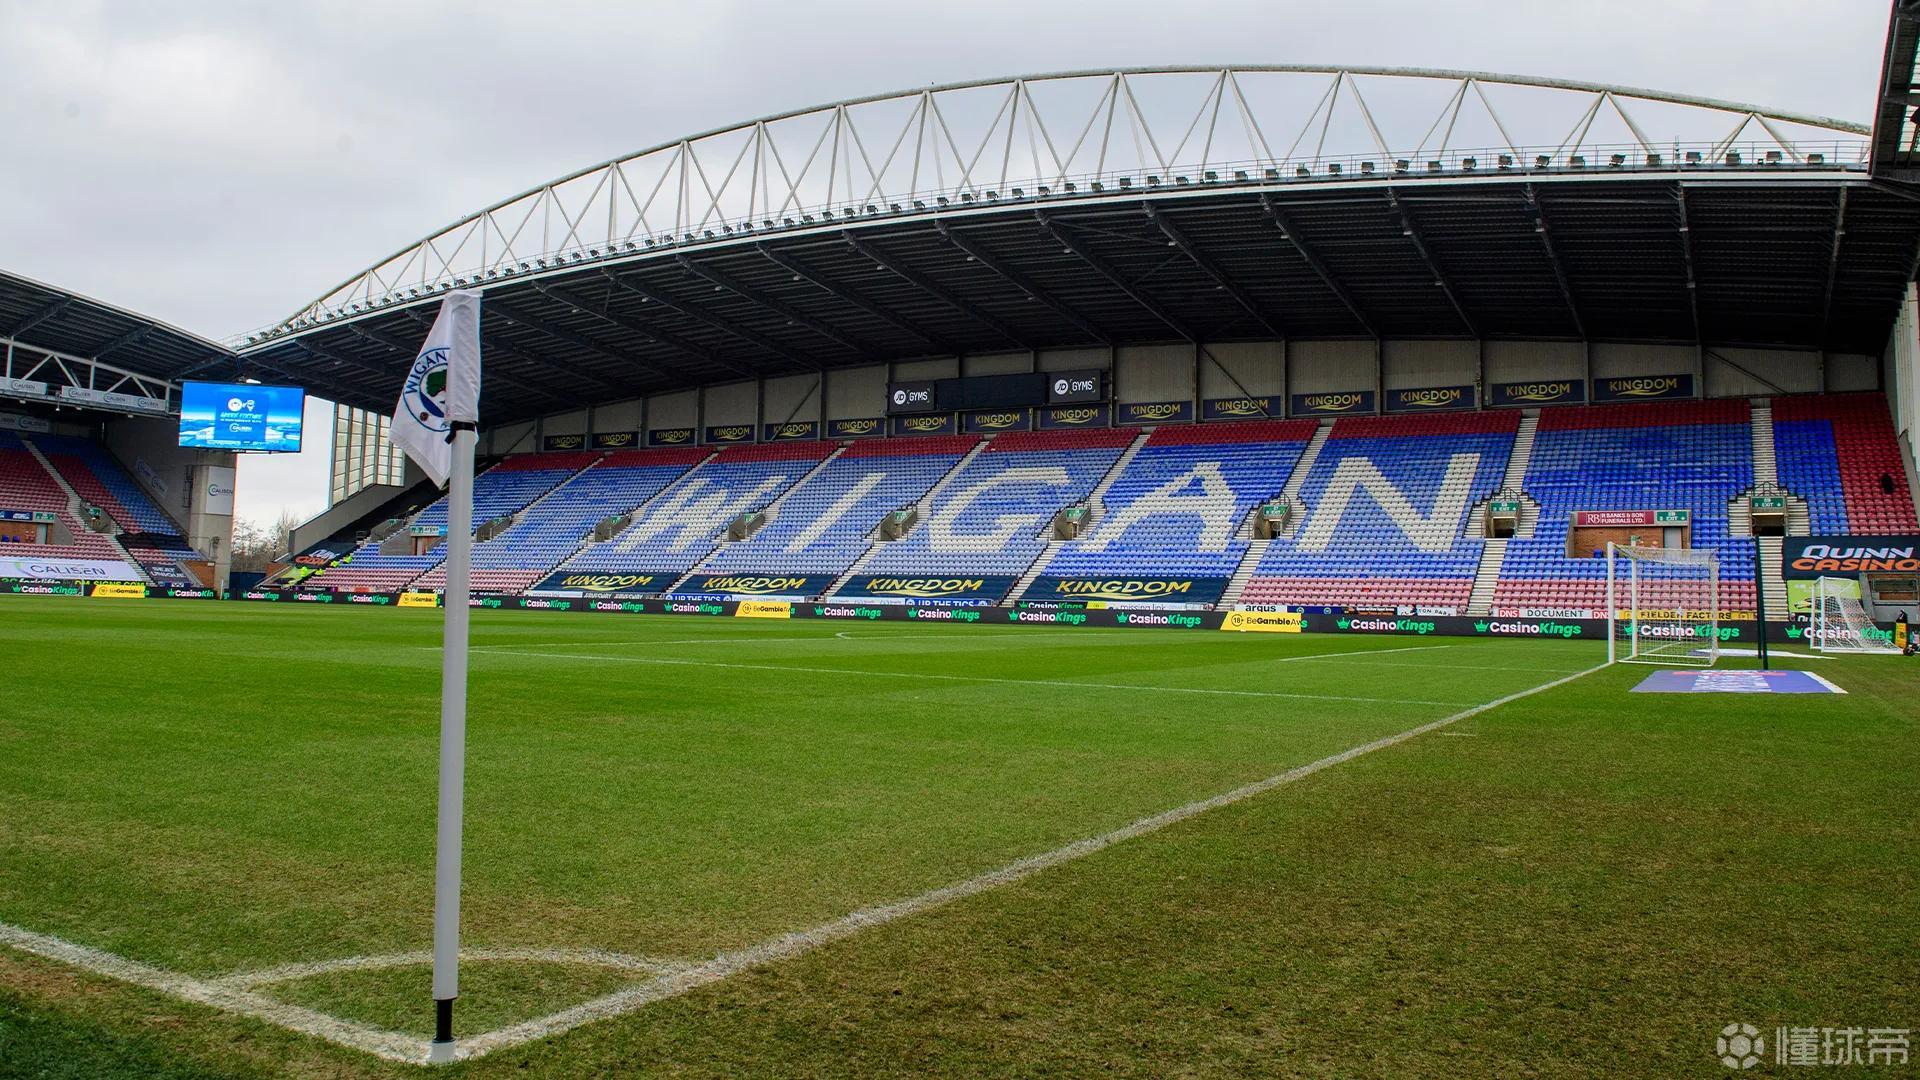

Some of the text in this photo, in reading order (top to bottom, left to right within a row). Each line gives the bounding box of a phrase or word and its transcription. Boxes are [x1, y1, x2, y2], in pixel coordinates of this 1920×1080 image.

[405, 350, 447, 394] WIGAN
[1072, 380, 1093, 392] GYMS
[1506, 383, 1570, 396] KINGDOM
[1609, 378, 1678, 392] KINGDOM
[909, 391, 928, 402] GYMS
[1305, 394, 1361, 407] KINGDOM
[1400, 389, 1461, 402] KINGDOM
[1051, 409, 1098, 421] KINGDOM
[1130, 404, 1181, 416] KINGDOM
[904, 416, 947, 428] KINGDOM
[975, 413, 1020, 424] KINGDOM
[837, 420, 877, 430] KINGDOM
[656, 430, 690, 439] KINGDOM
[714, 427, 750, 437] KINGDOM
[599, 434, 632, 443] KINGDOM
[611, 453, 1480, 552] WIGAN
[1587, 513, 1600, 524] RB
[1801, 545, 1914, 559] QUINN
[30, 564, 106, 576] CALISEN
[561, 575, 653, 586] KINGDOM
[703, 577, 807, 590] KINGDOM
[866, 578, 984, 591] KINGDOM
[1055, 580, 1192, 593] KINGDOM
[21, 585, 79, 596] CasinoKings
[469, 598, 502, 609] sinoKings
[526, 599, 571, 611] CasinoKings
[596, 600, 644, 613] CasinoKings
[672, 602, 723, 615] CasinoKings
[823, 606, 882, 620] CasinoKings
[917, 608, 980, 622] CasinoKings
[1018, 610, 1087, 625] CasinoKings
[1499, 609, 1519, 618] DNS
[1526, 609, 1584, 618] DOCUMENT
[1686, 612, 1731, 620] FACTRS
[1128, 612, 1201, 628] CasinoKings
[1350, 618, 1435, 634] CasinoKings
[1489, 621, 1582, 638] CasinoKings
[1640, 624, 1740, 640] CasinoKings
